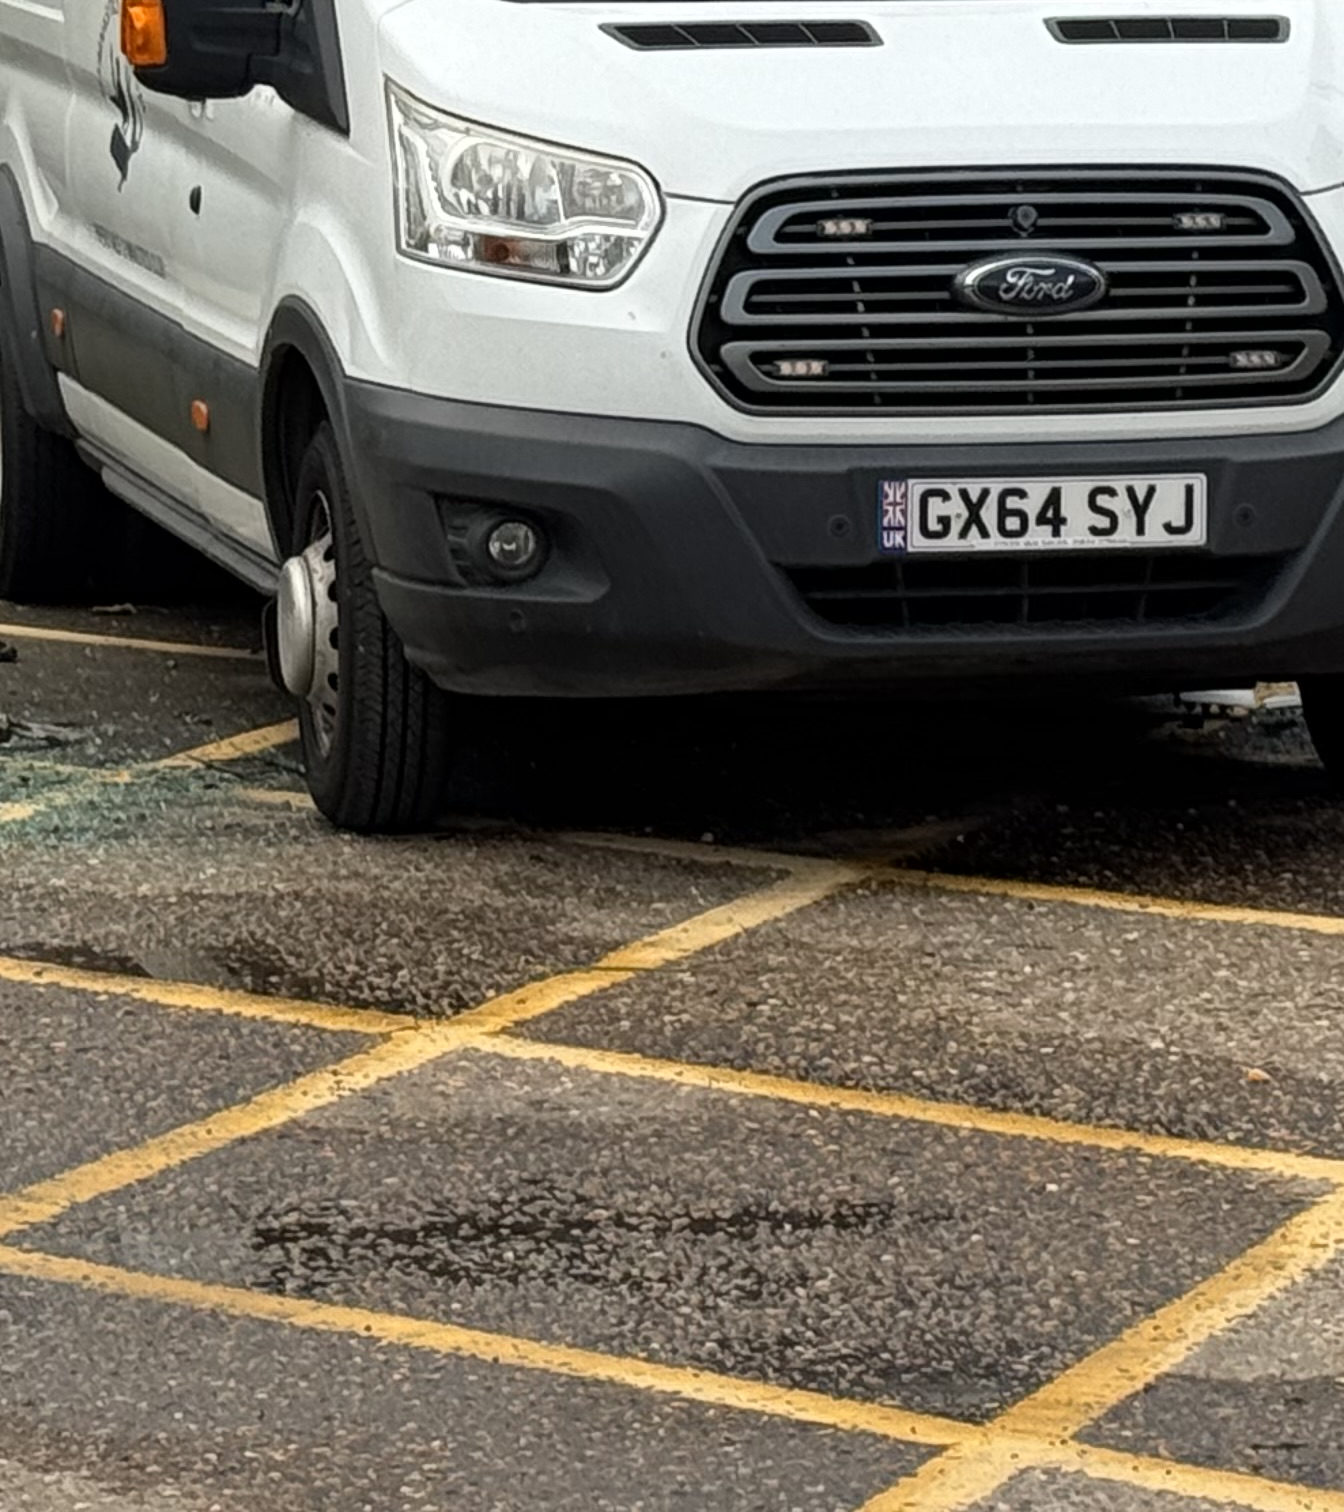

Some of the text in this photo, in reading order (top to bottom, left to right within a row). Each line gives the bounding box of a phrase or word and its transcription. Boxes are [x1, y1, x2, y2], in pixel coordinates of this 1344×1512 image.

[999, 267, 1076, 301] Ford
[918, 483, 1195, 540] GX64 SYJ
[883, 530, 906, 549] UK
